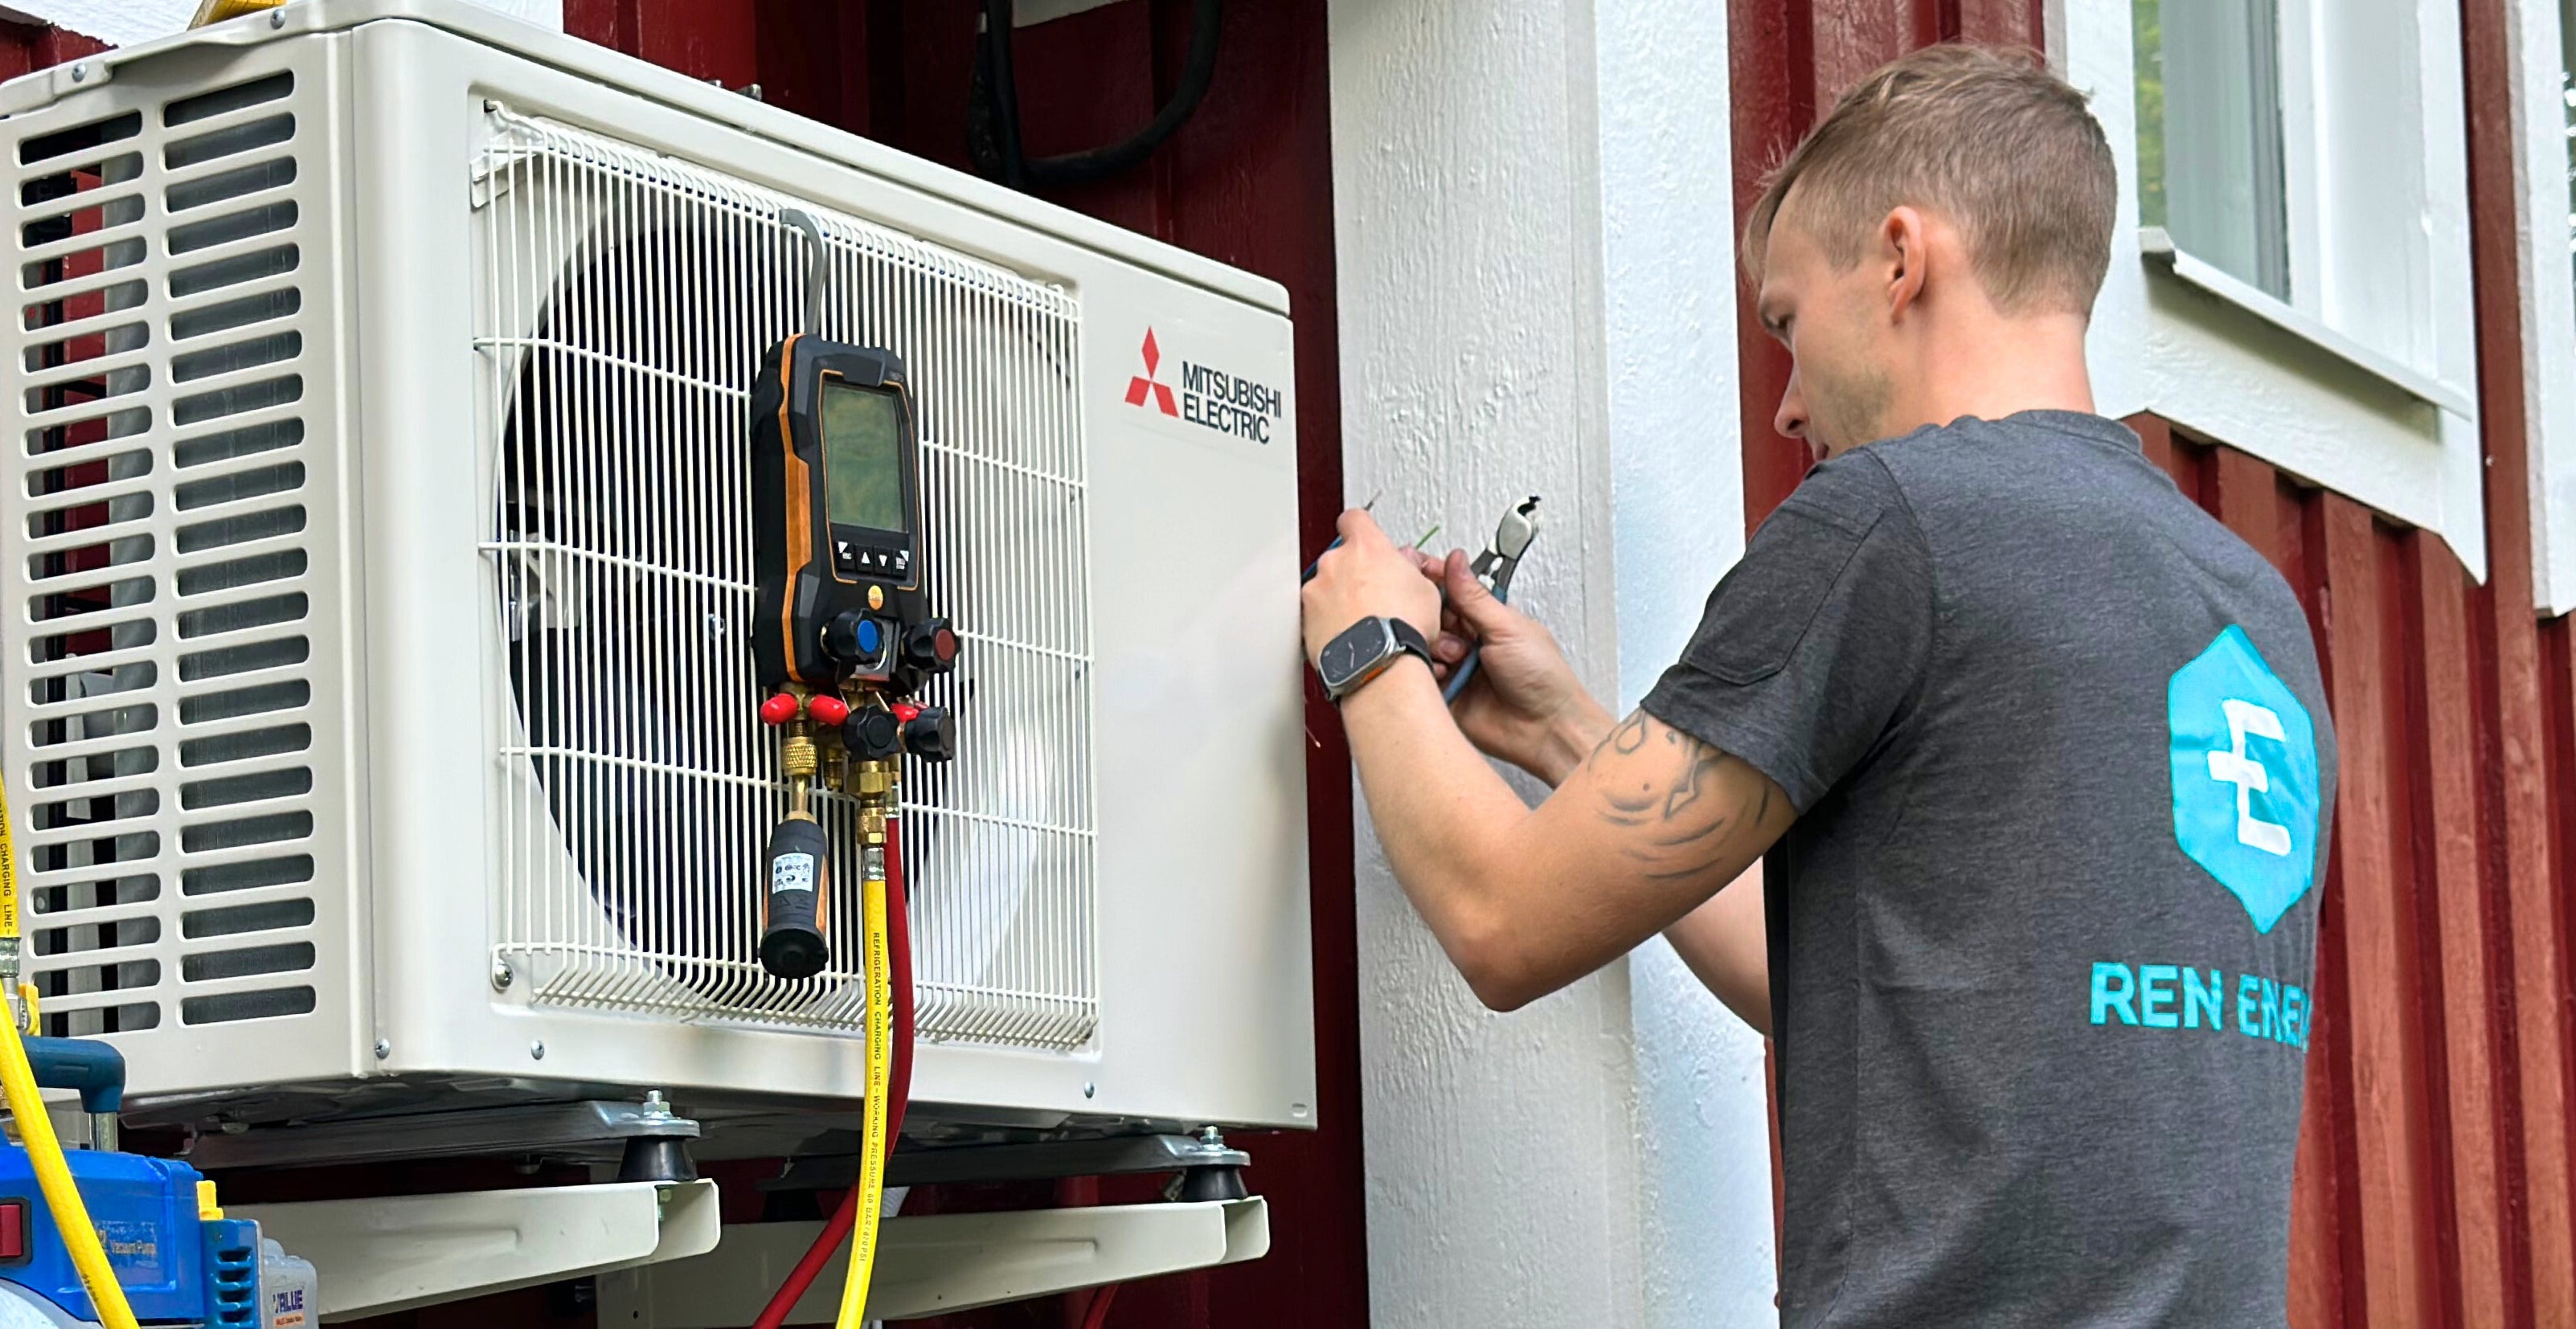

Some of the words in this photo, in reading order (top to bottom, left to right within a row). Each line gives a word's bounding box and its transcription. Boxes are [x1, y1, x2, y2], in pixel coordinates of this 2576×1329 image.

[1182, 360, 1281, 418] MITSUBISHI
[1184, 392, 1270, 444] ELECTRIC
[1, 844, 11, 897] CHARGING
[873, 932, 882, 1006] REFRIGERATION
[2091, 961, 2224, 1031] REN
[874, 1011, 882, 1060] CHARGING
